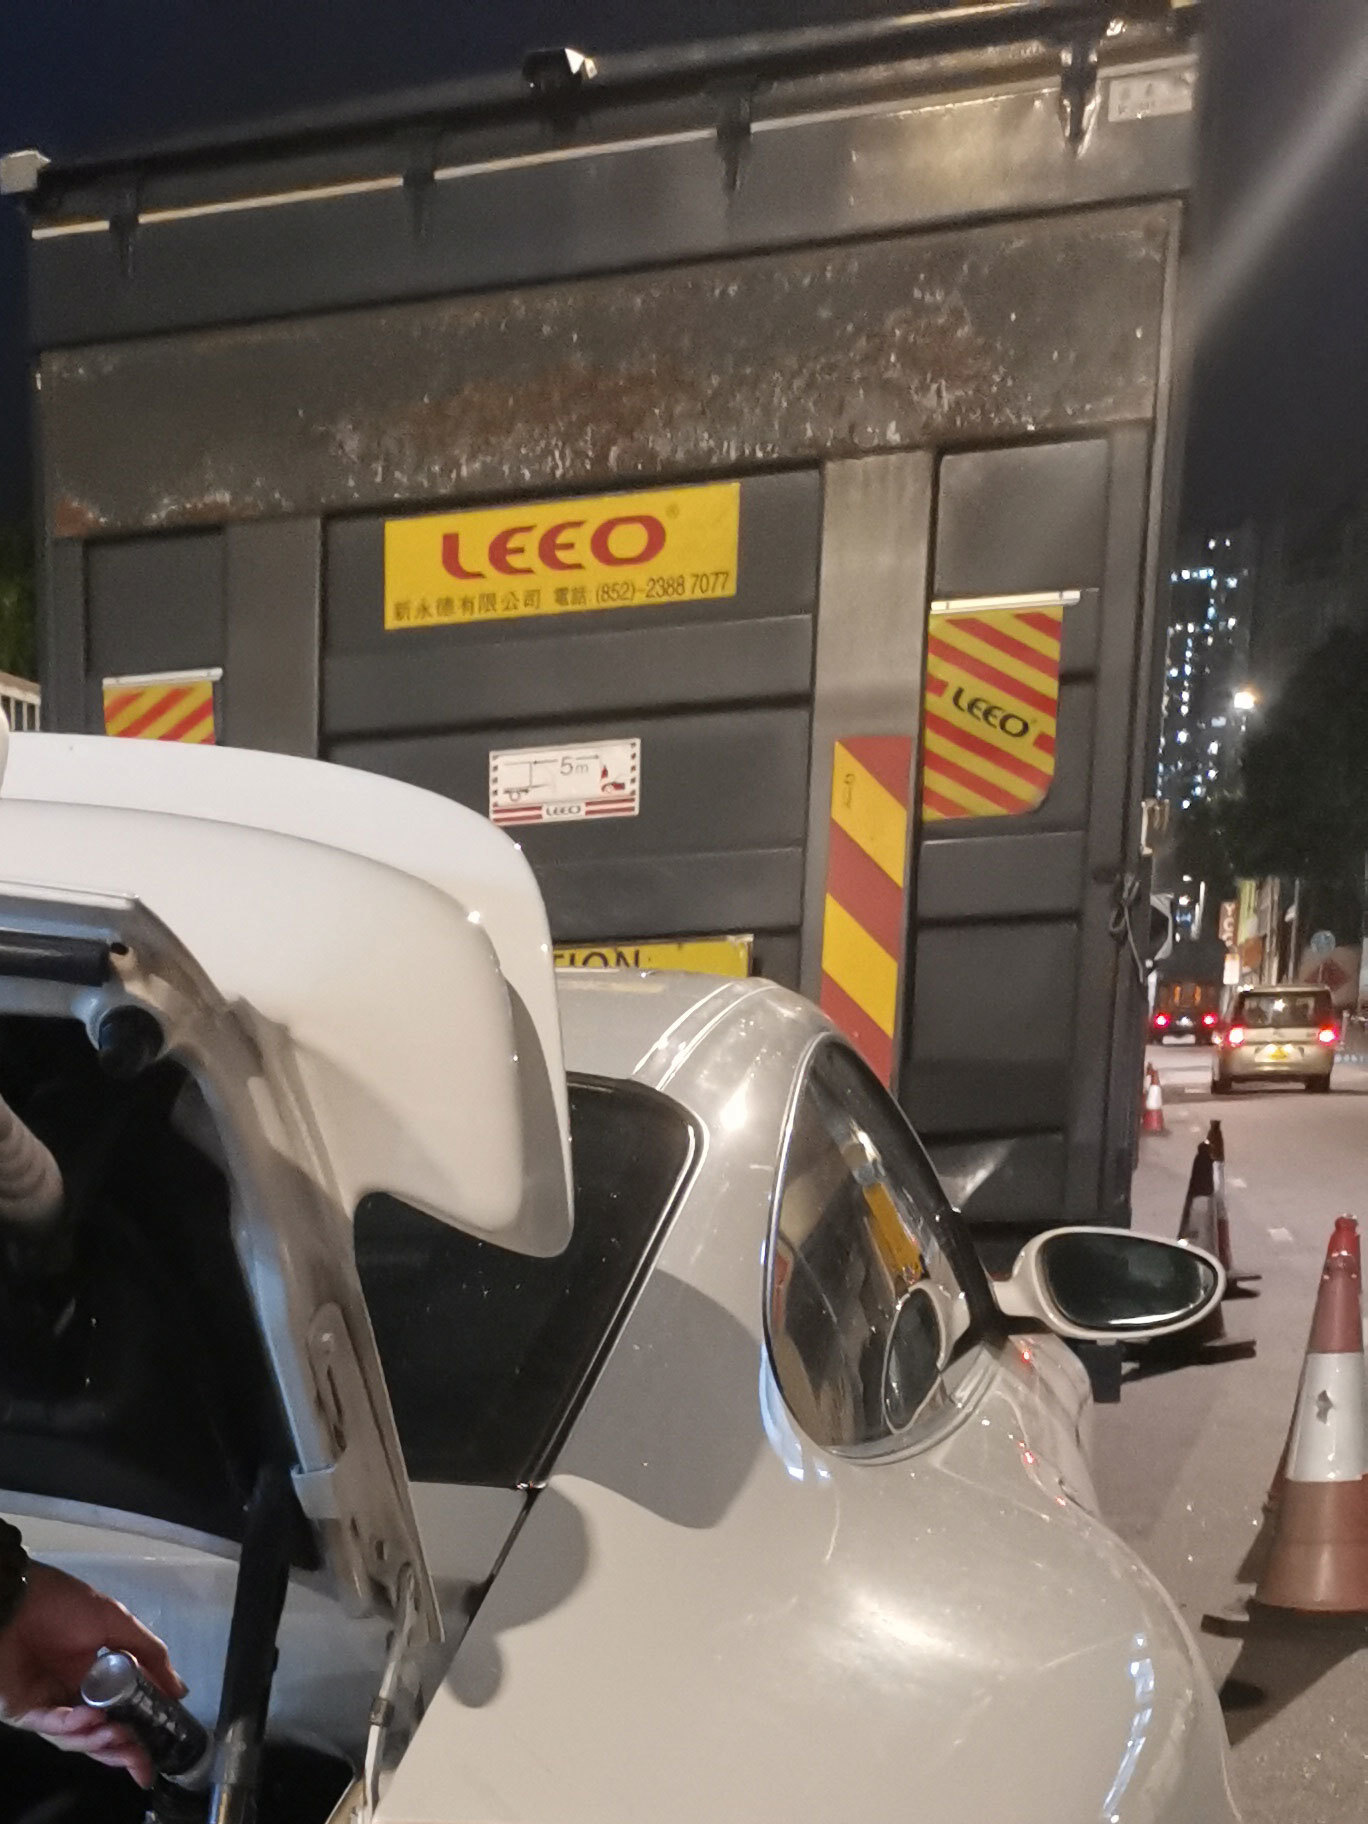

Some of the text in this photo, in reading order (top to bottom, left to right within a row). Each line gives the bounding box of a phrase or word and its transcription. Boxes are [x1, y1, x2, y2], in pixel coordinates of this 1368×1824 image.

[441, 514, 667, 580] LEEO
[691, 571, 729, 594] 7077
[952, 686, 1030, 738] LEEO
